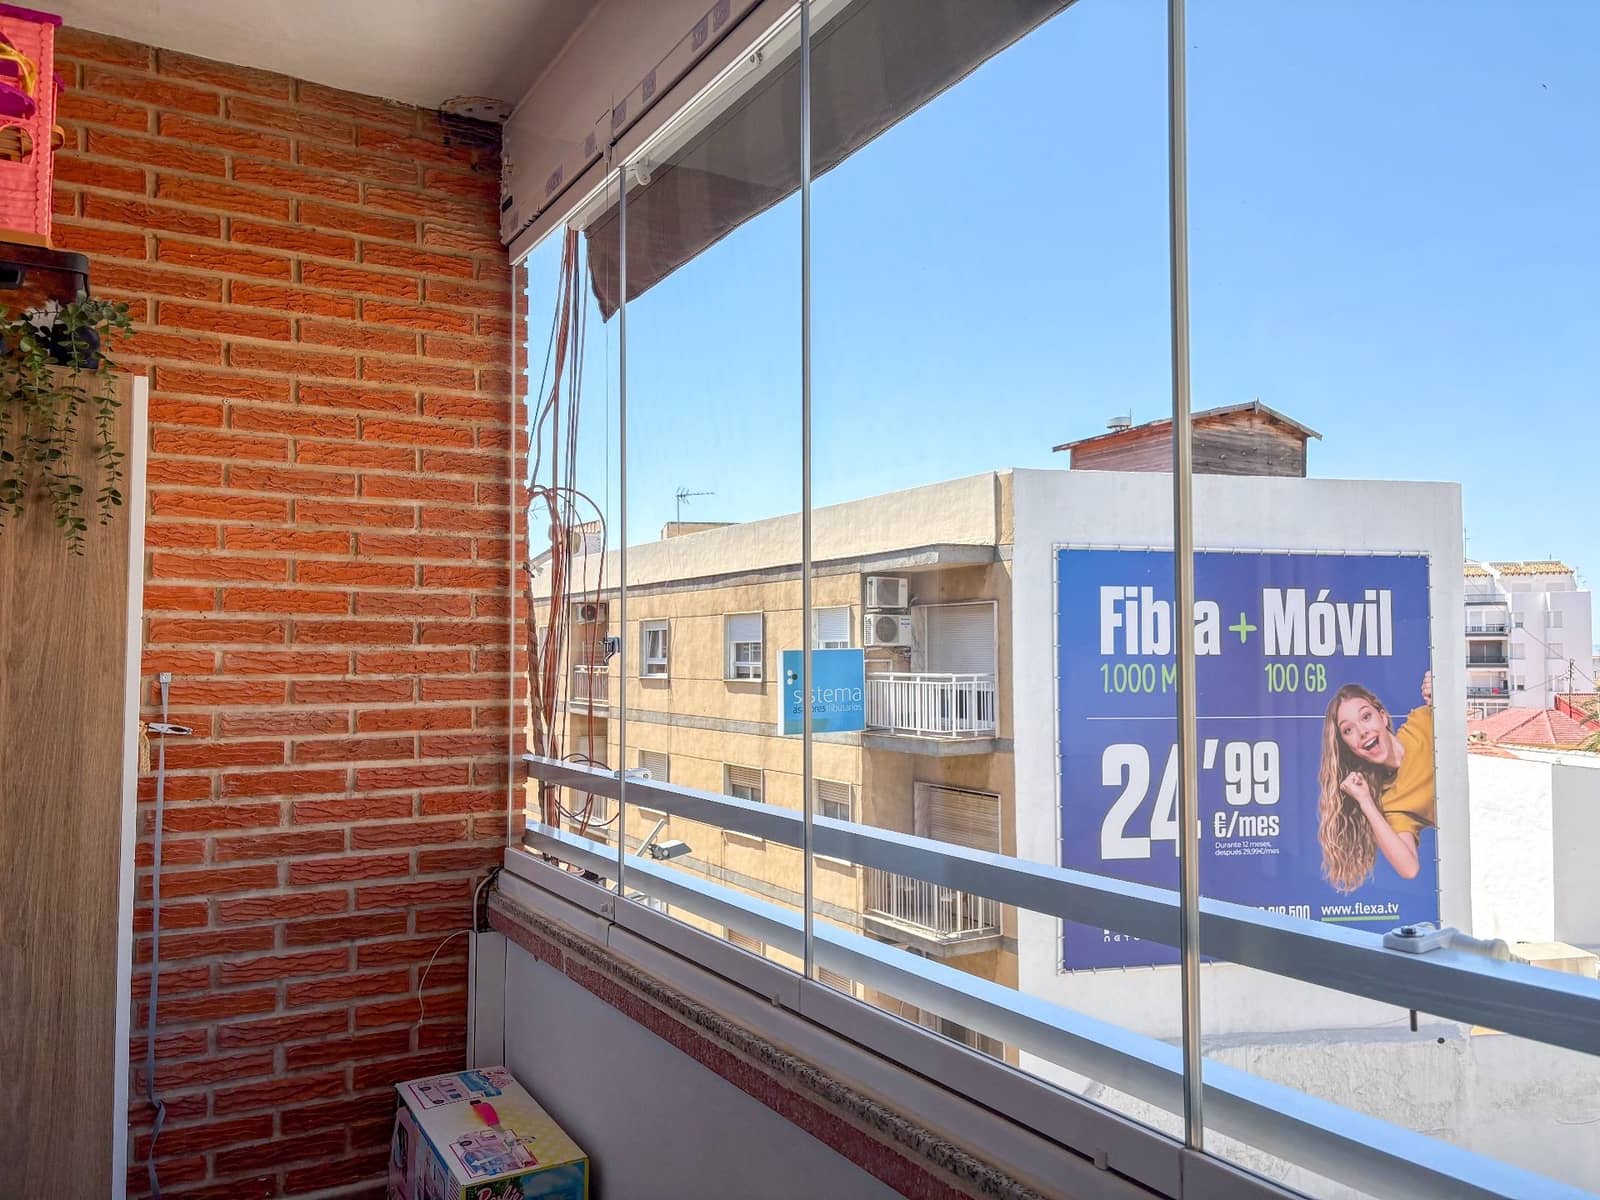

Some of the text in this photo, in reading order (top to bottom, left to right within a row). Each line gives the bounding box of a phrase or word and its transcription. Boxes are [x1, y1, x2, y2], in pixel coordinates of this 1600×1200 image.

[1100, 585, 1221, 656] Fiba
[1262, 588, 1393, 656] Móvil
[1100, 663, 1179, 693] 1.000 M
[1263, 663, 1328, 693] 100 GB
[1214, 811, 1280, 839] €/mes
[1321, 902, 1400, 917] www.flexa.tv
